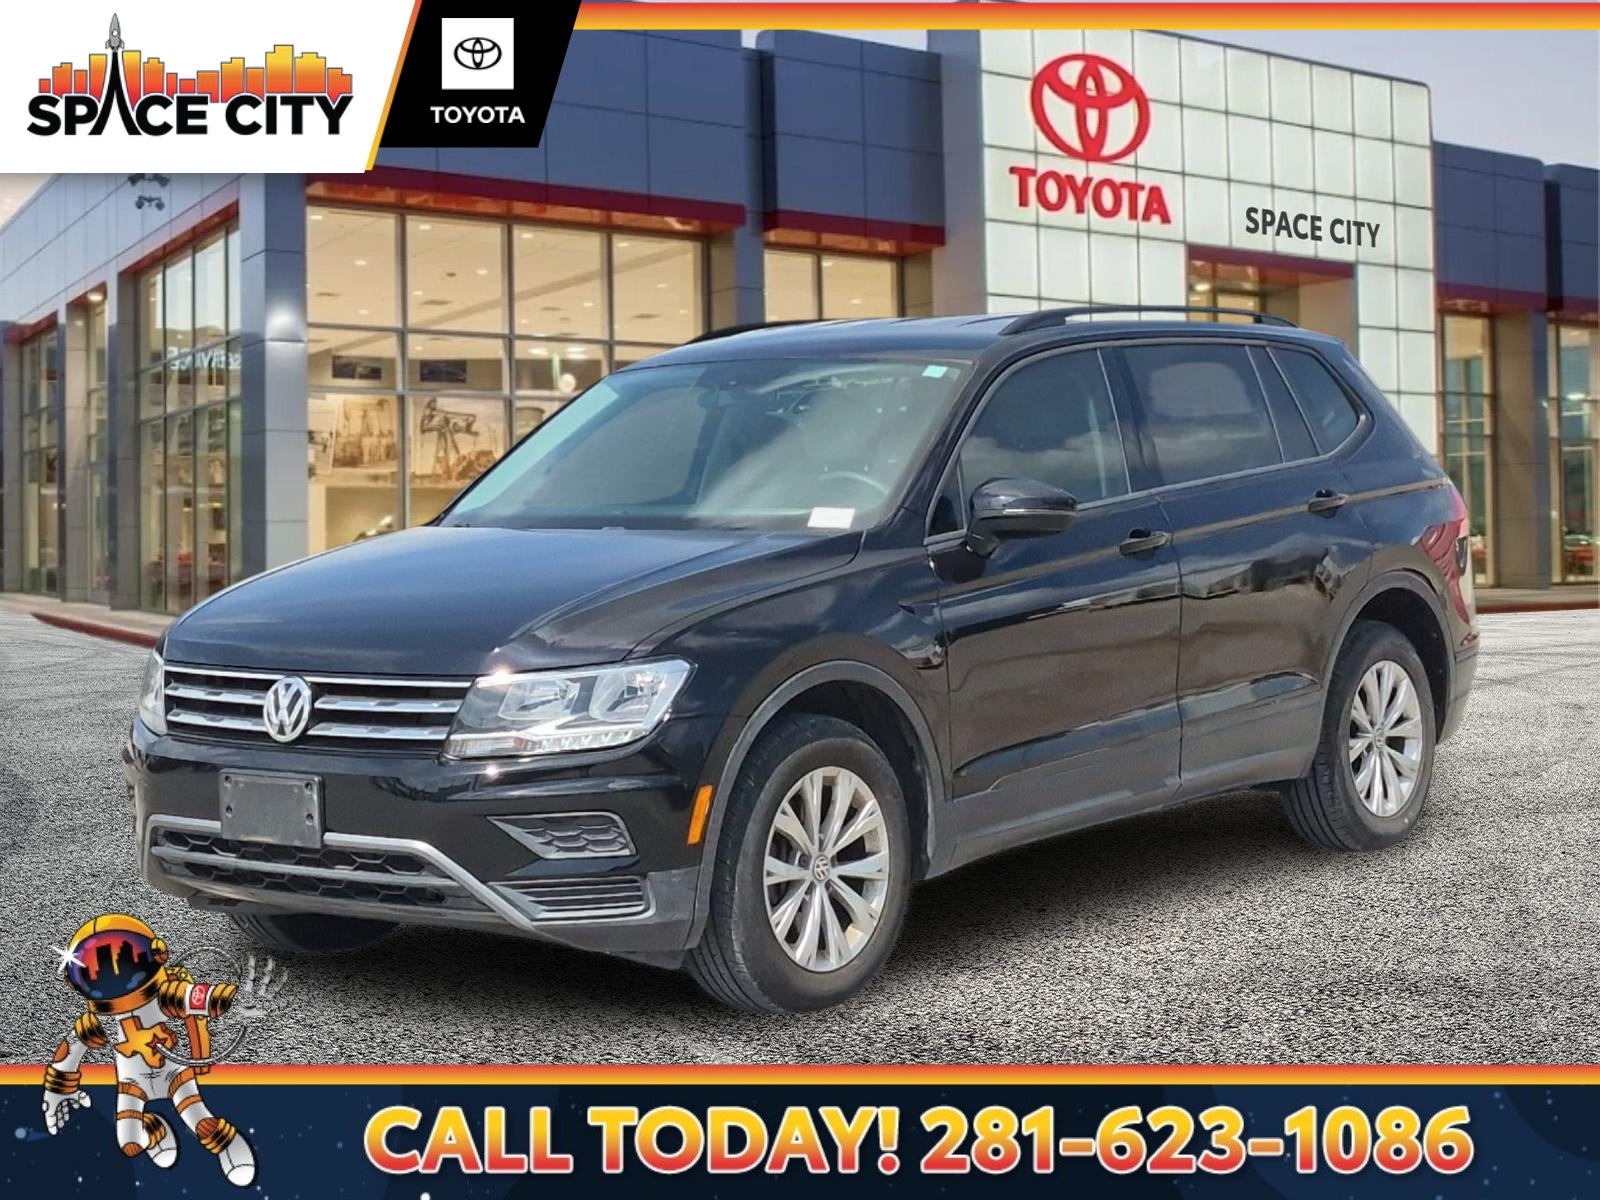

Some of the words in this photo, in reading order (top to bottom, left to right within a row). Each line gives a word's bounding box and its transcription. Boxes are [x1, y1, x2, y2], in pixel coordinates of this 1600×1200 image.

[1009, 166, 1171, 225] TOYOTA
[1245, 206, 1323, 243] SPACE
[1329, 217, 1381, 248] CITY
